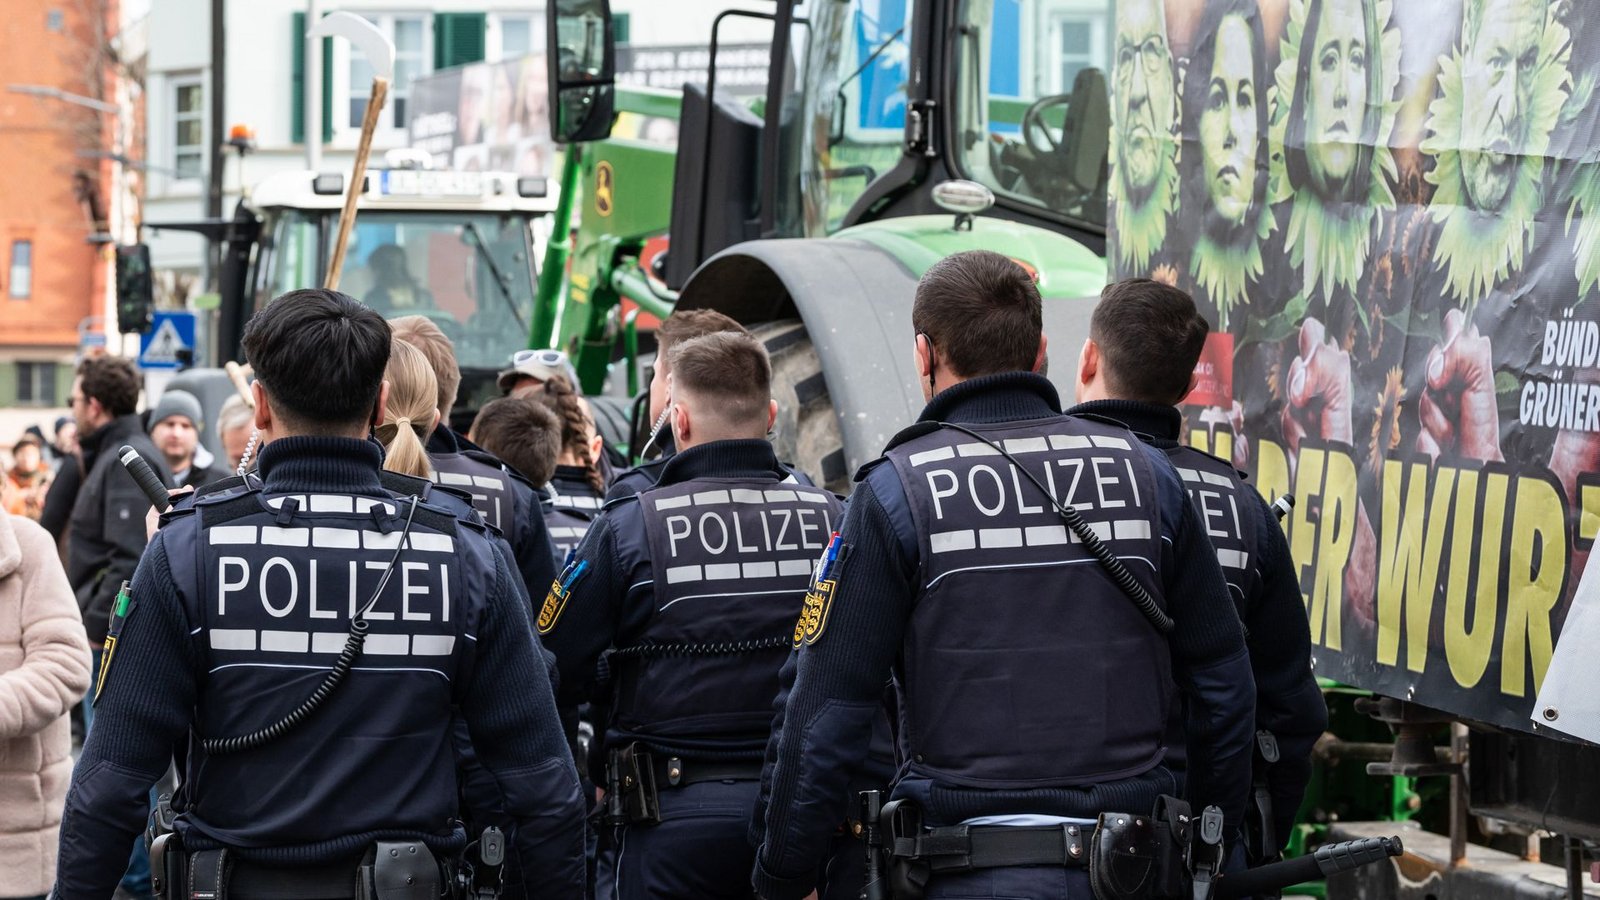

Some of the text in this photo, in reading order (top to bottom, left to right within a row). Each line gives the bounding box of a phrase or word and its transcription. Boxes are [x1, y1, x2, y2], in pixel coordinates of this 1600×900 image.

[1541, 307, 1600, 368] BÜND
[925, 457, 1141, 520] POLIZEI
[1188, 489, 1242, 540] EI
[666, 508, 832, 558] POLIZEI
[218, 556, 450, 622] POLIZEI
